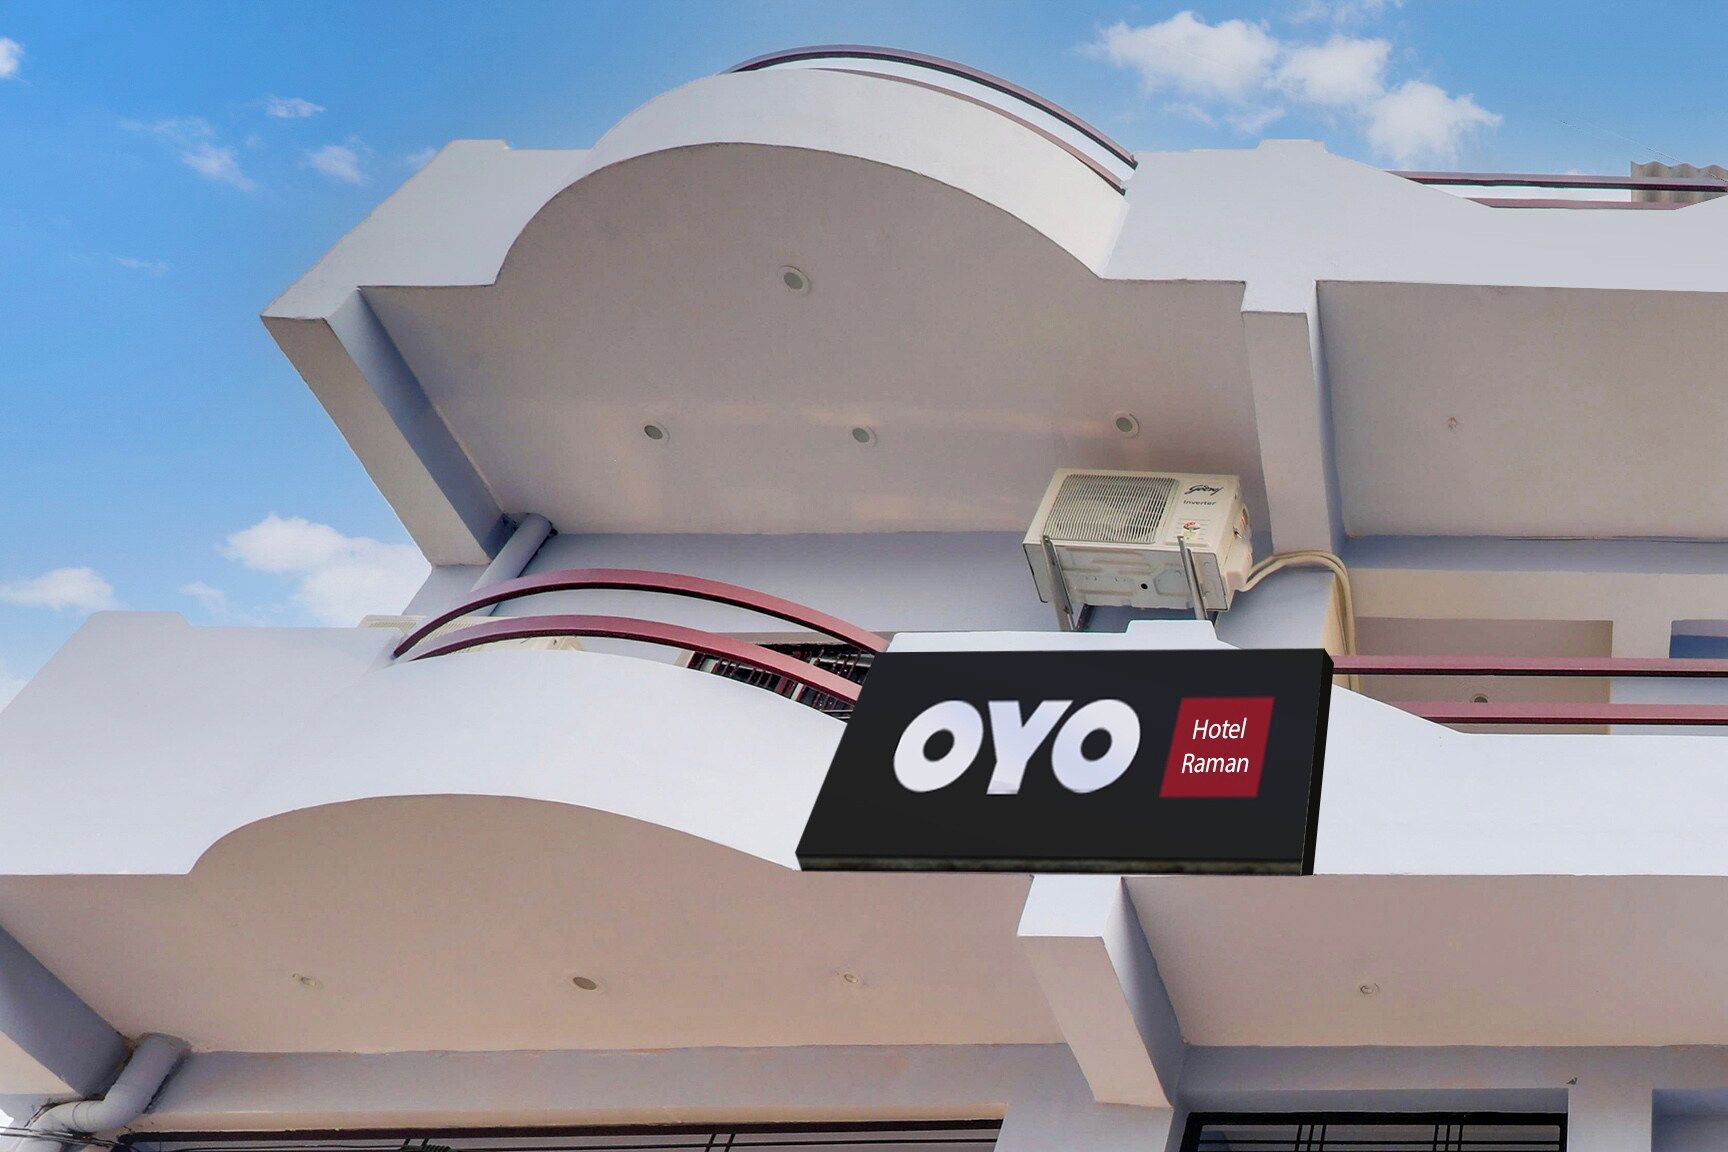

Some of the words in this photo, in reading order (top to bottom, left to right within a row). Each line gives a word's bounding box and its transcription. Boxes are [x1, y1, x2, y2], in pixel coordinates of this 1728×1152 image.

[1192, 717, 1247, 739] Hotel
[893, 699, 1141, 795] OYO
[1181, 753, 1249, 774] Raman
